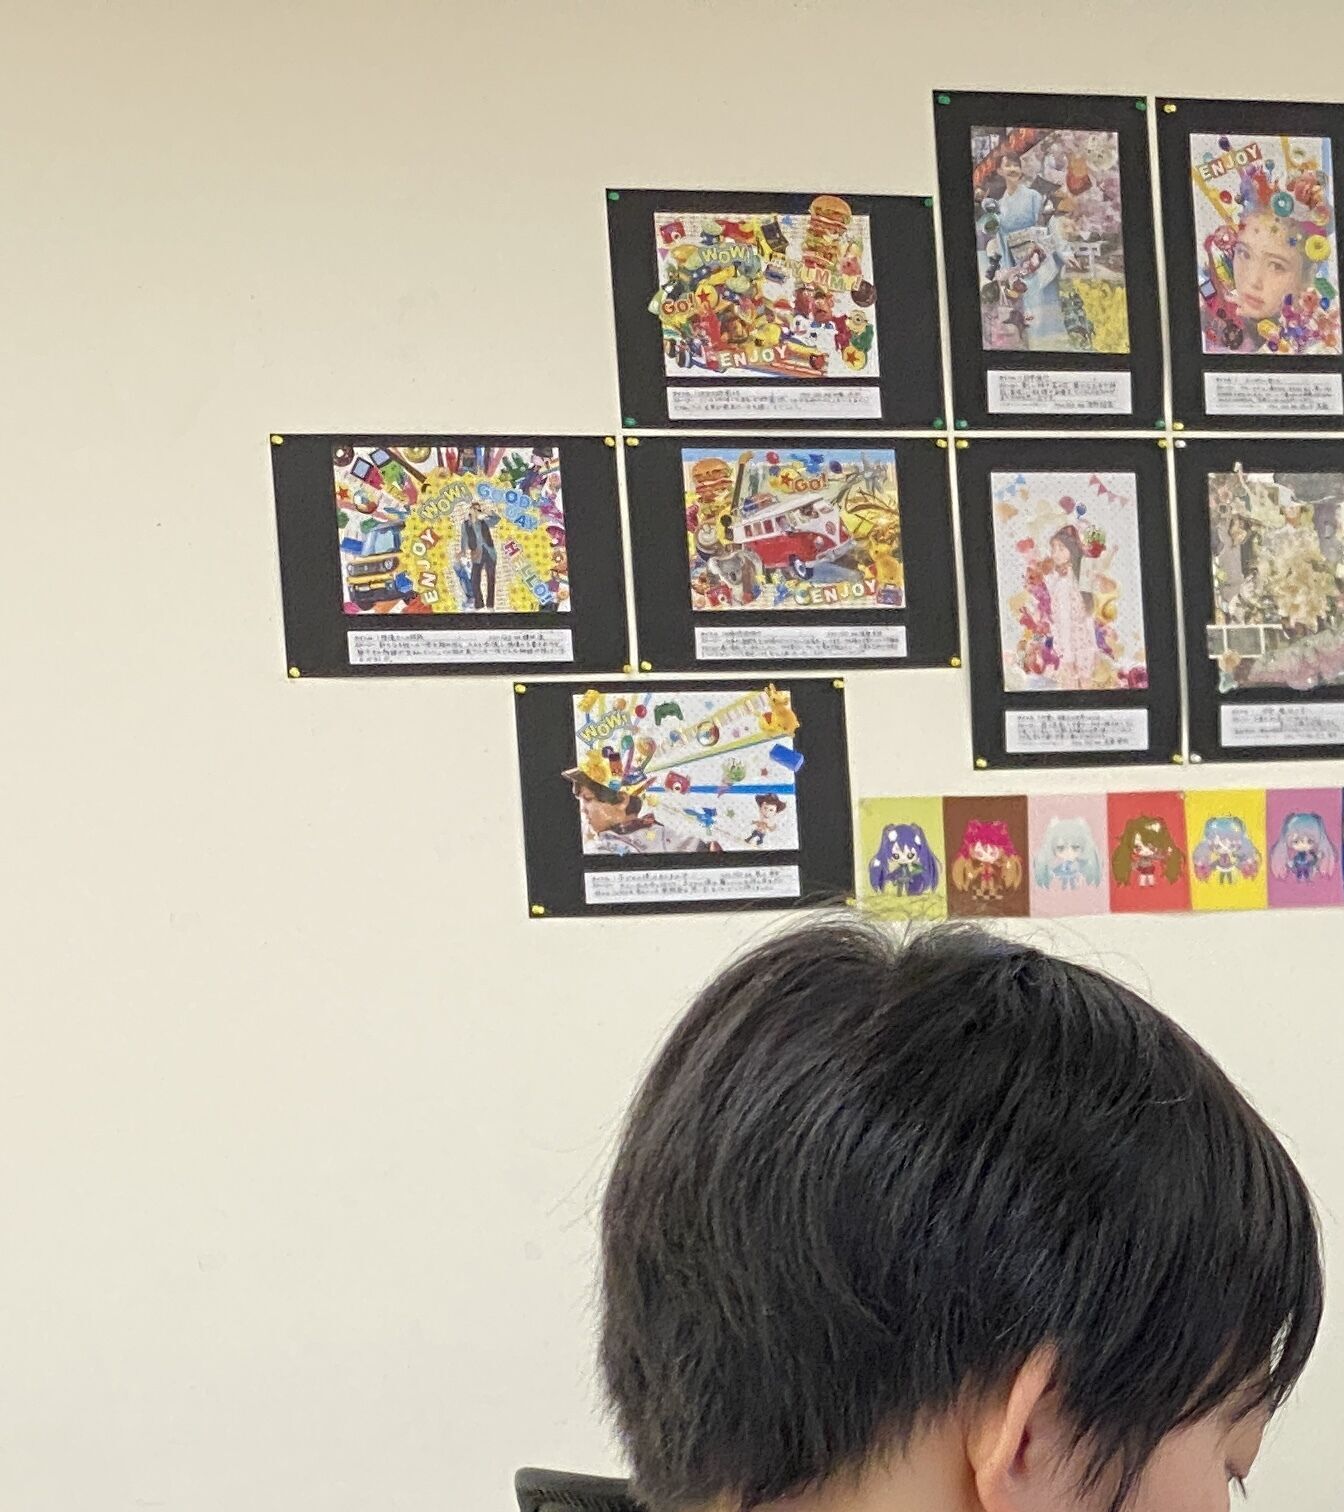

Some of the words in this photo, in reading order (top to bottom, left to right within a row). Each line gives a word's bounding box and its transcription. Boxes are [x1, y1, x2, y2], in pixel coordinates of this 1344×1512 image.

[1202, 144, 1260, 180] ENJOY
[661, 293, 696, 314] GO!
[719, 344, 787, 366] ENJOY
[794, 473, 829, 492] GO!
[412, 527, 440, 604] ENJOY
[811, 578, 877, 604] ENJOY
[580, 713, 629, 742] WOW!
